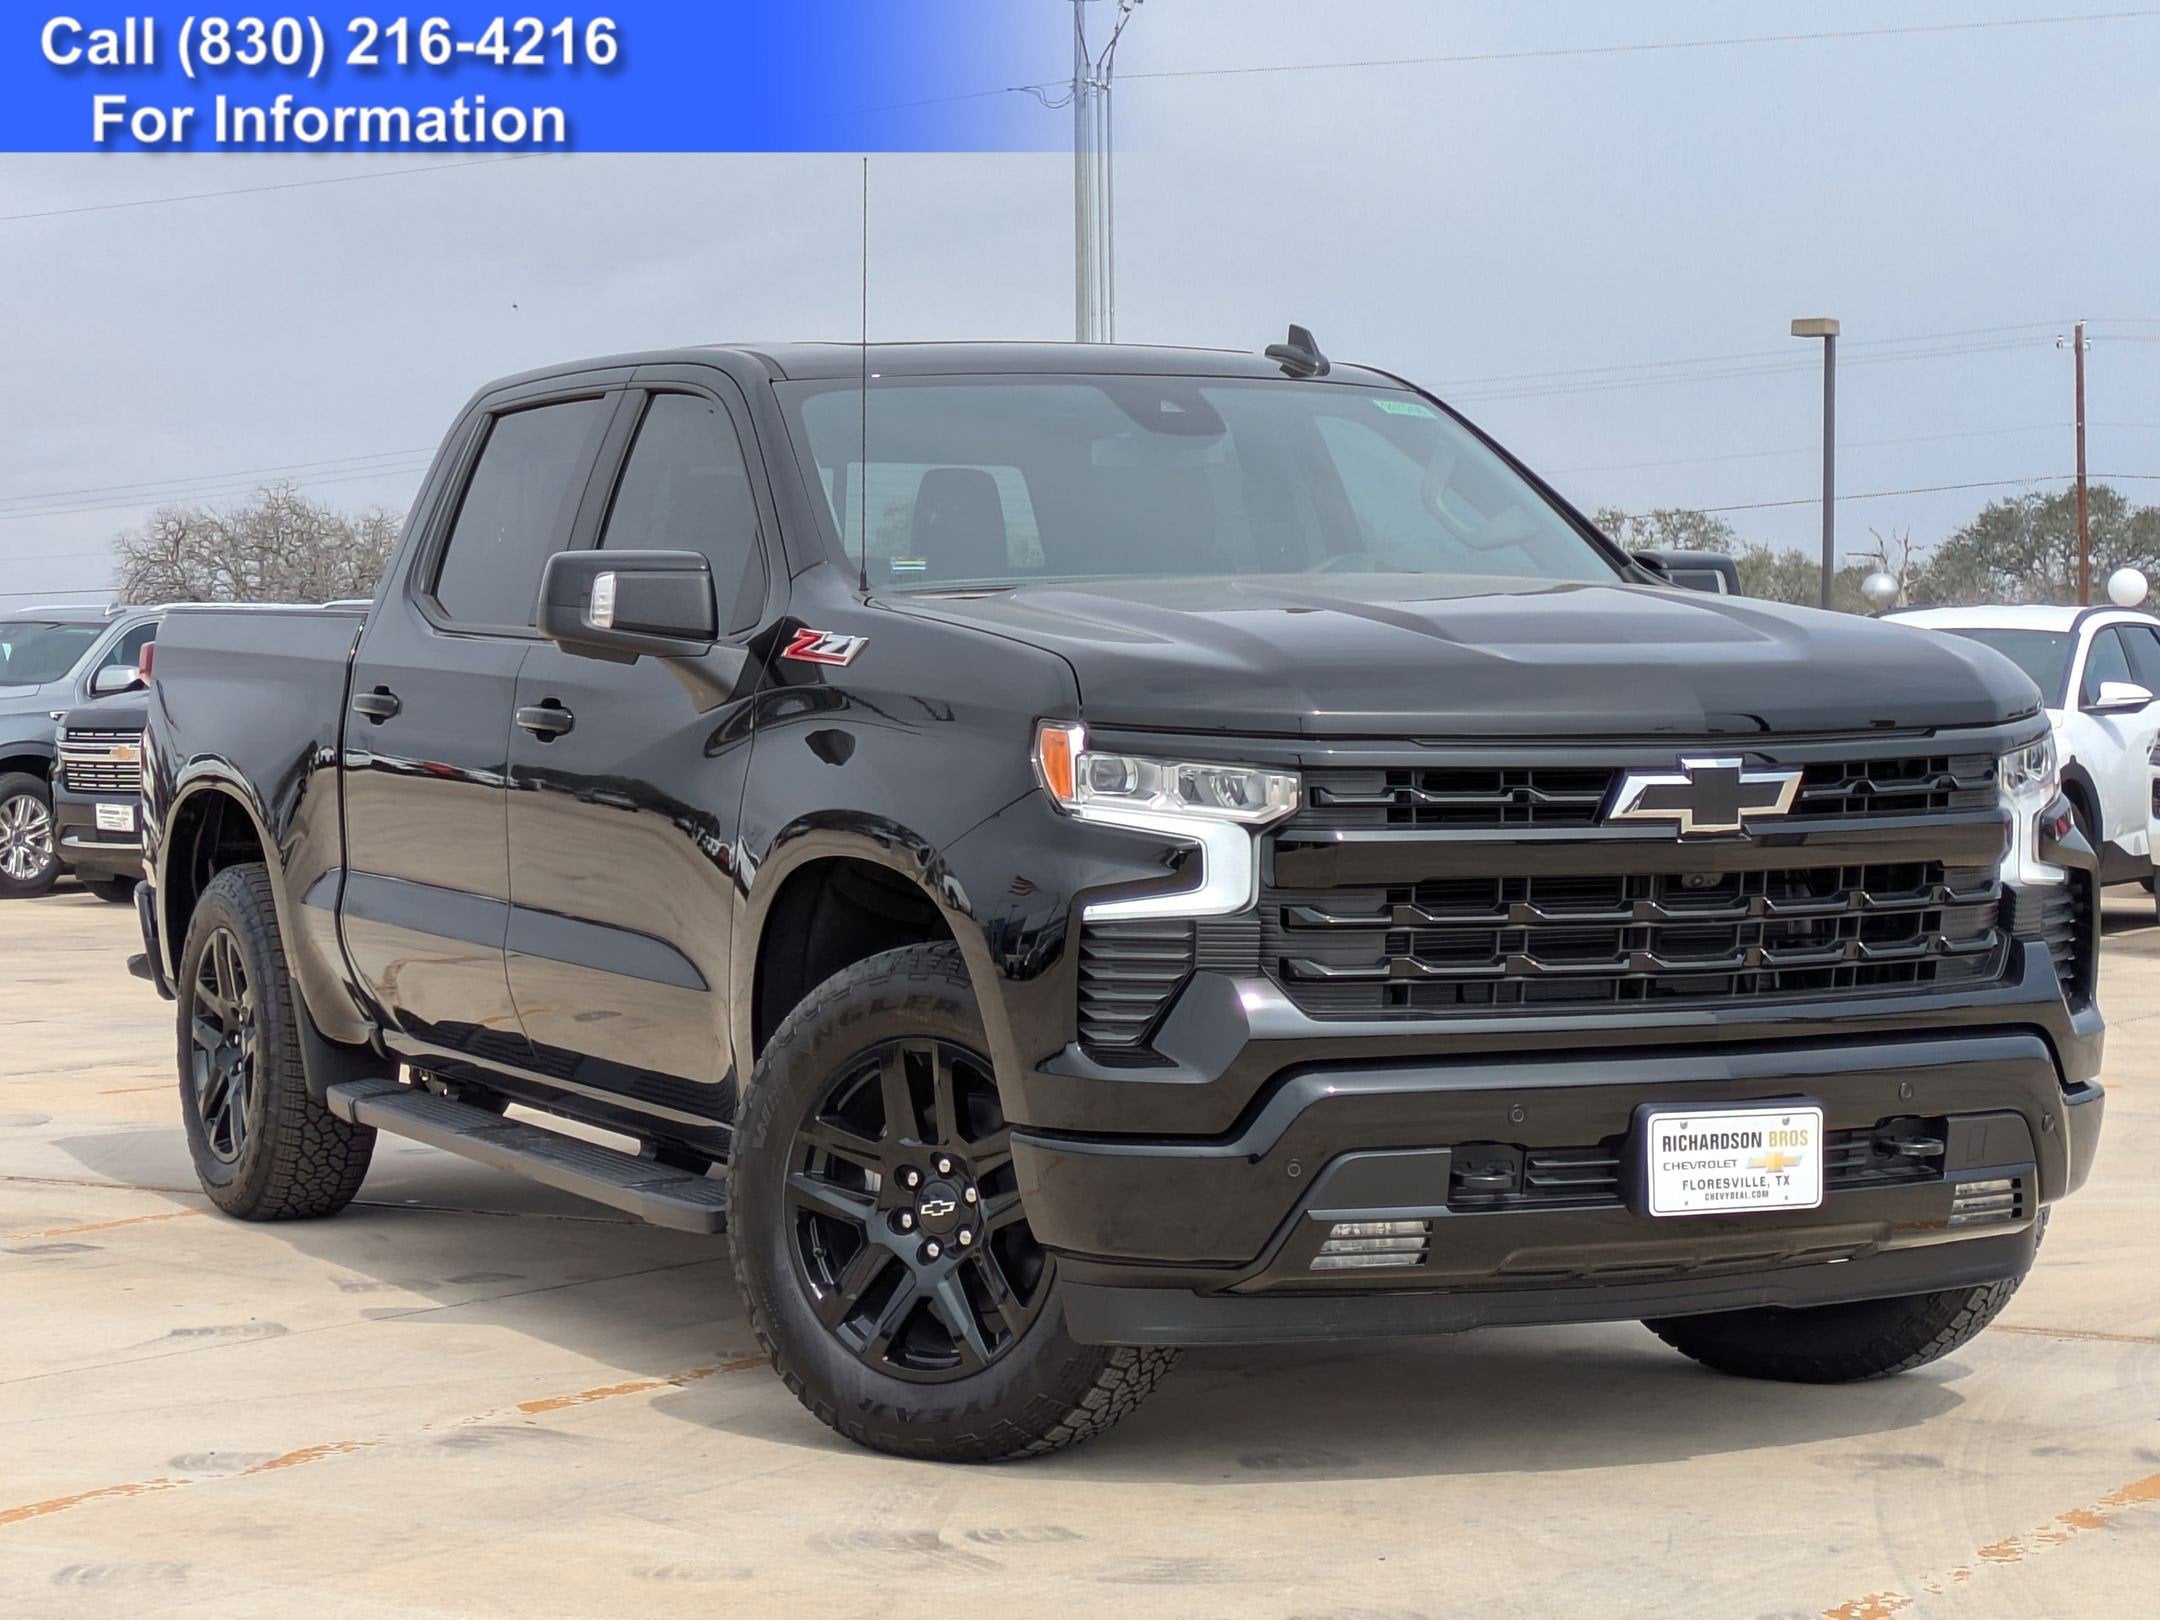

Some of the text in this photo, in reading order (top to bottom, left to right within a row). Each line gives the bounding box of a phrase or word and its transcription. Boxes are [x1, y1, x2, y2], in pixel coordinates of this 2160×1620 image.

[781, 627, 869, 667] Z71
[1662, 1129, 1809, 1153] RICHARDSON BROS
[1663, 1159, 1738, 1171] CHEVROLET
[1682, 1174, 1790, 1191] FLORESVILLE, TX
[1704, 1190, 1769, 1201] CHEVYDEAL.COM
